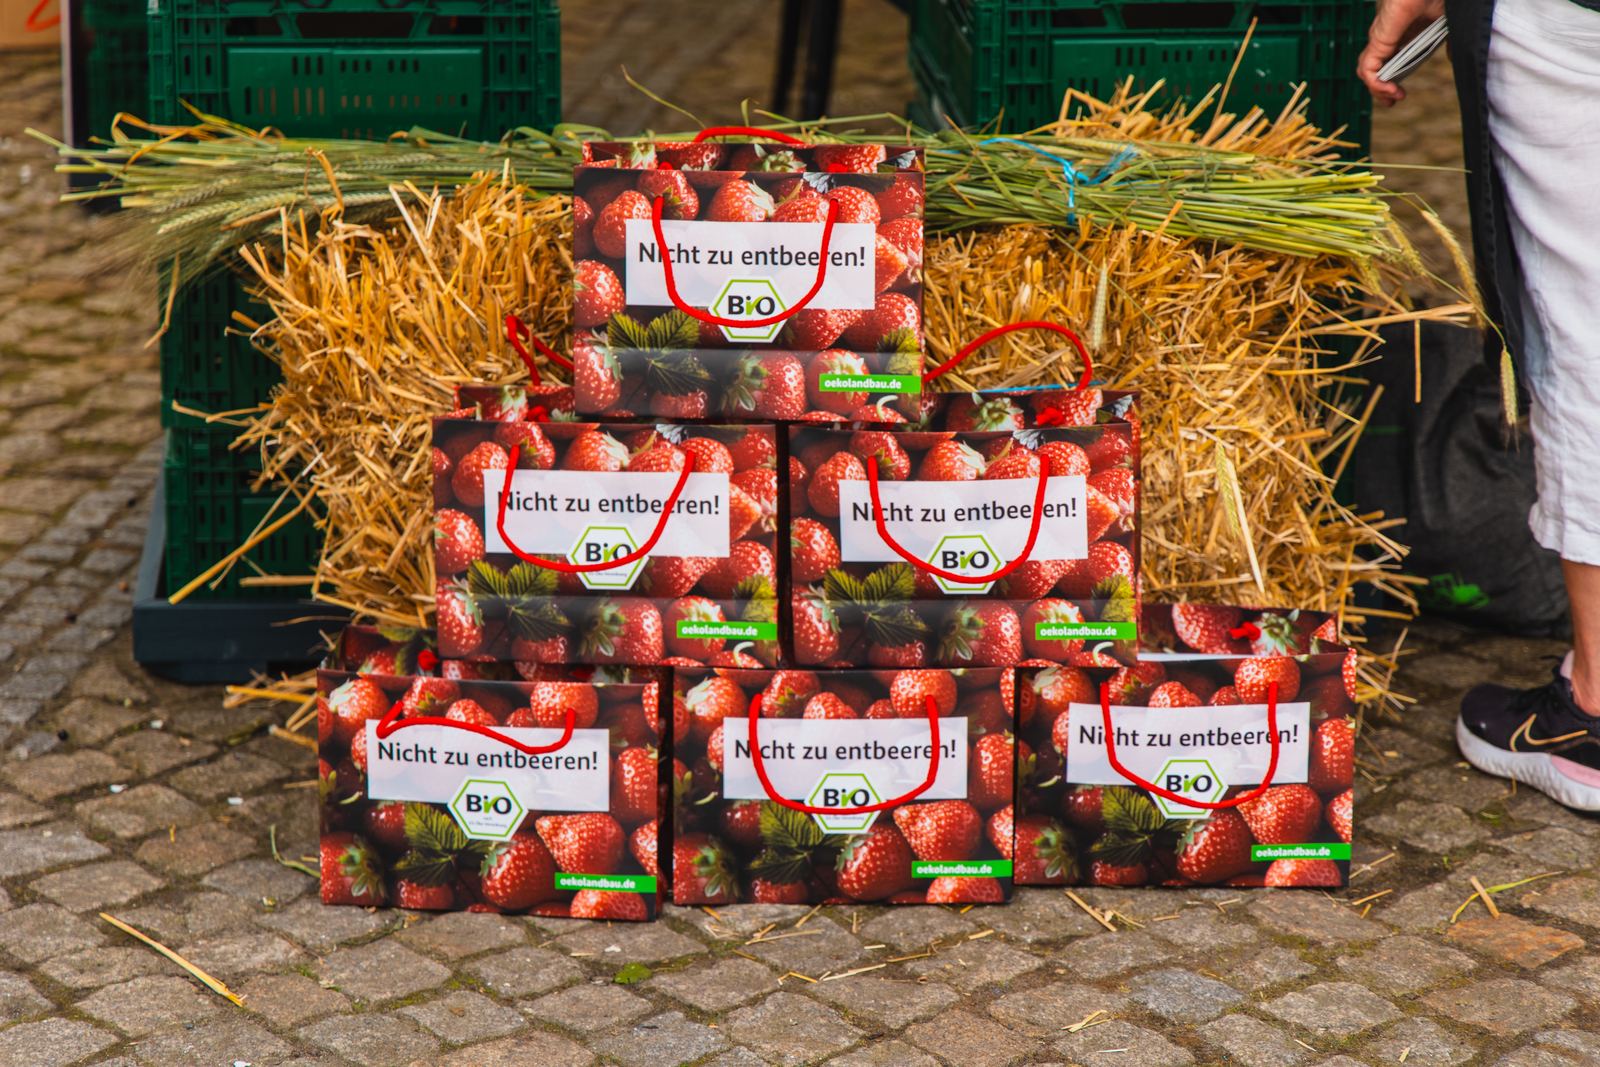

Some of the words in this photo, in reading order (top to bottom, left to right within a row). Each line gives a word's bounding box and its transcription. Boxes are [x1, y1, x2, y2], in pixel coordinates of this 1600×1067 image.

[639, 243, 700, 264] Nht
[708, 250, 733, 264] zu
[742, 245, 865, 267] entbeeen!
[825, 378, 901, 389] oekolandbau.de
[498, 492, 558, 512] Nicht
[566, 498, 590, 512] zu
[921, 509, 946, 522] zu
[954, 497, 1077, 521] entbeeen!
[682, 626, 757, 636] oekolandbau.de
[1040, 627, 1117, 637] oekolandbau.de
[1079, 725, 1139, 746] Niht
[1147, 734, 1171, 746] zu
[378, 742, 437, 763] Nicht
[444, 752, 468, 766] zu
[477, 750, 598, 770] entbeeren!
[735, 740, 795, 759] Ncht
[803, 746, 827, 760] zu
[836, 739, 955, 760] entbeeren!
[1256, 847, 1331, 857] oekolandbau.de
[917, 865, 992, 874] oekolandbau.de
[560, 877, 635, 888] oekolandbau.de
